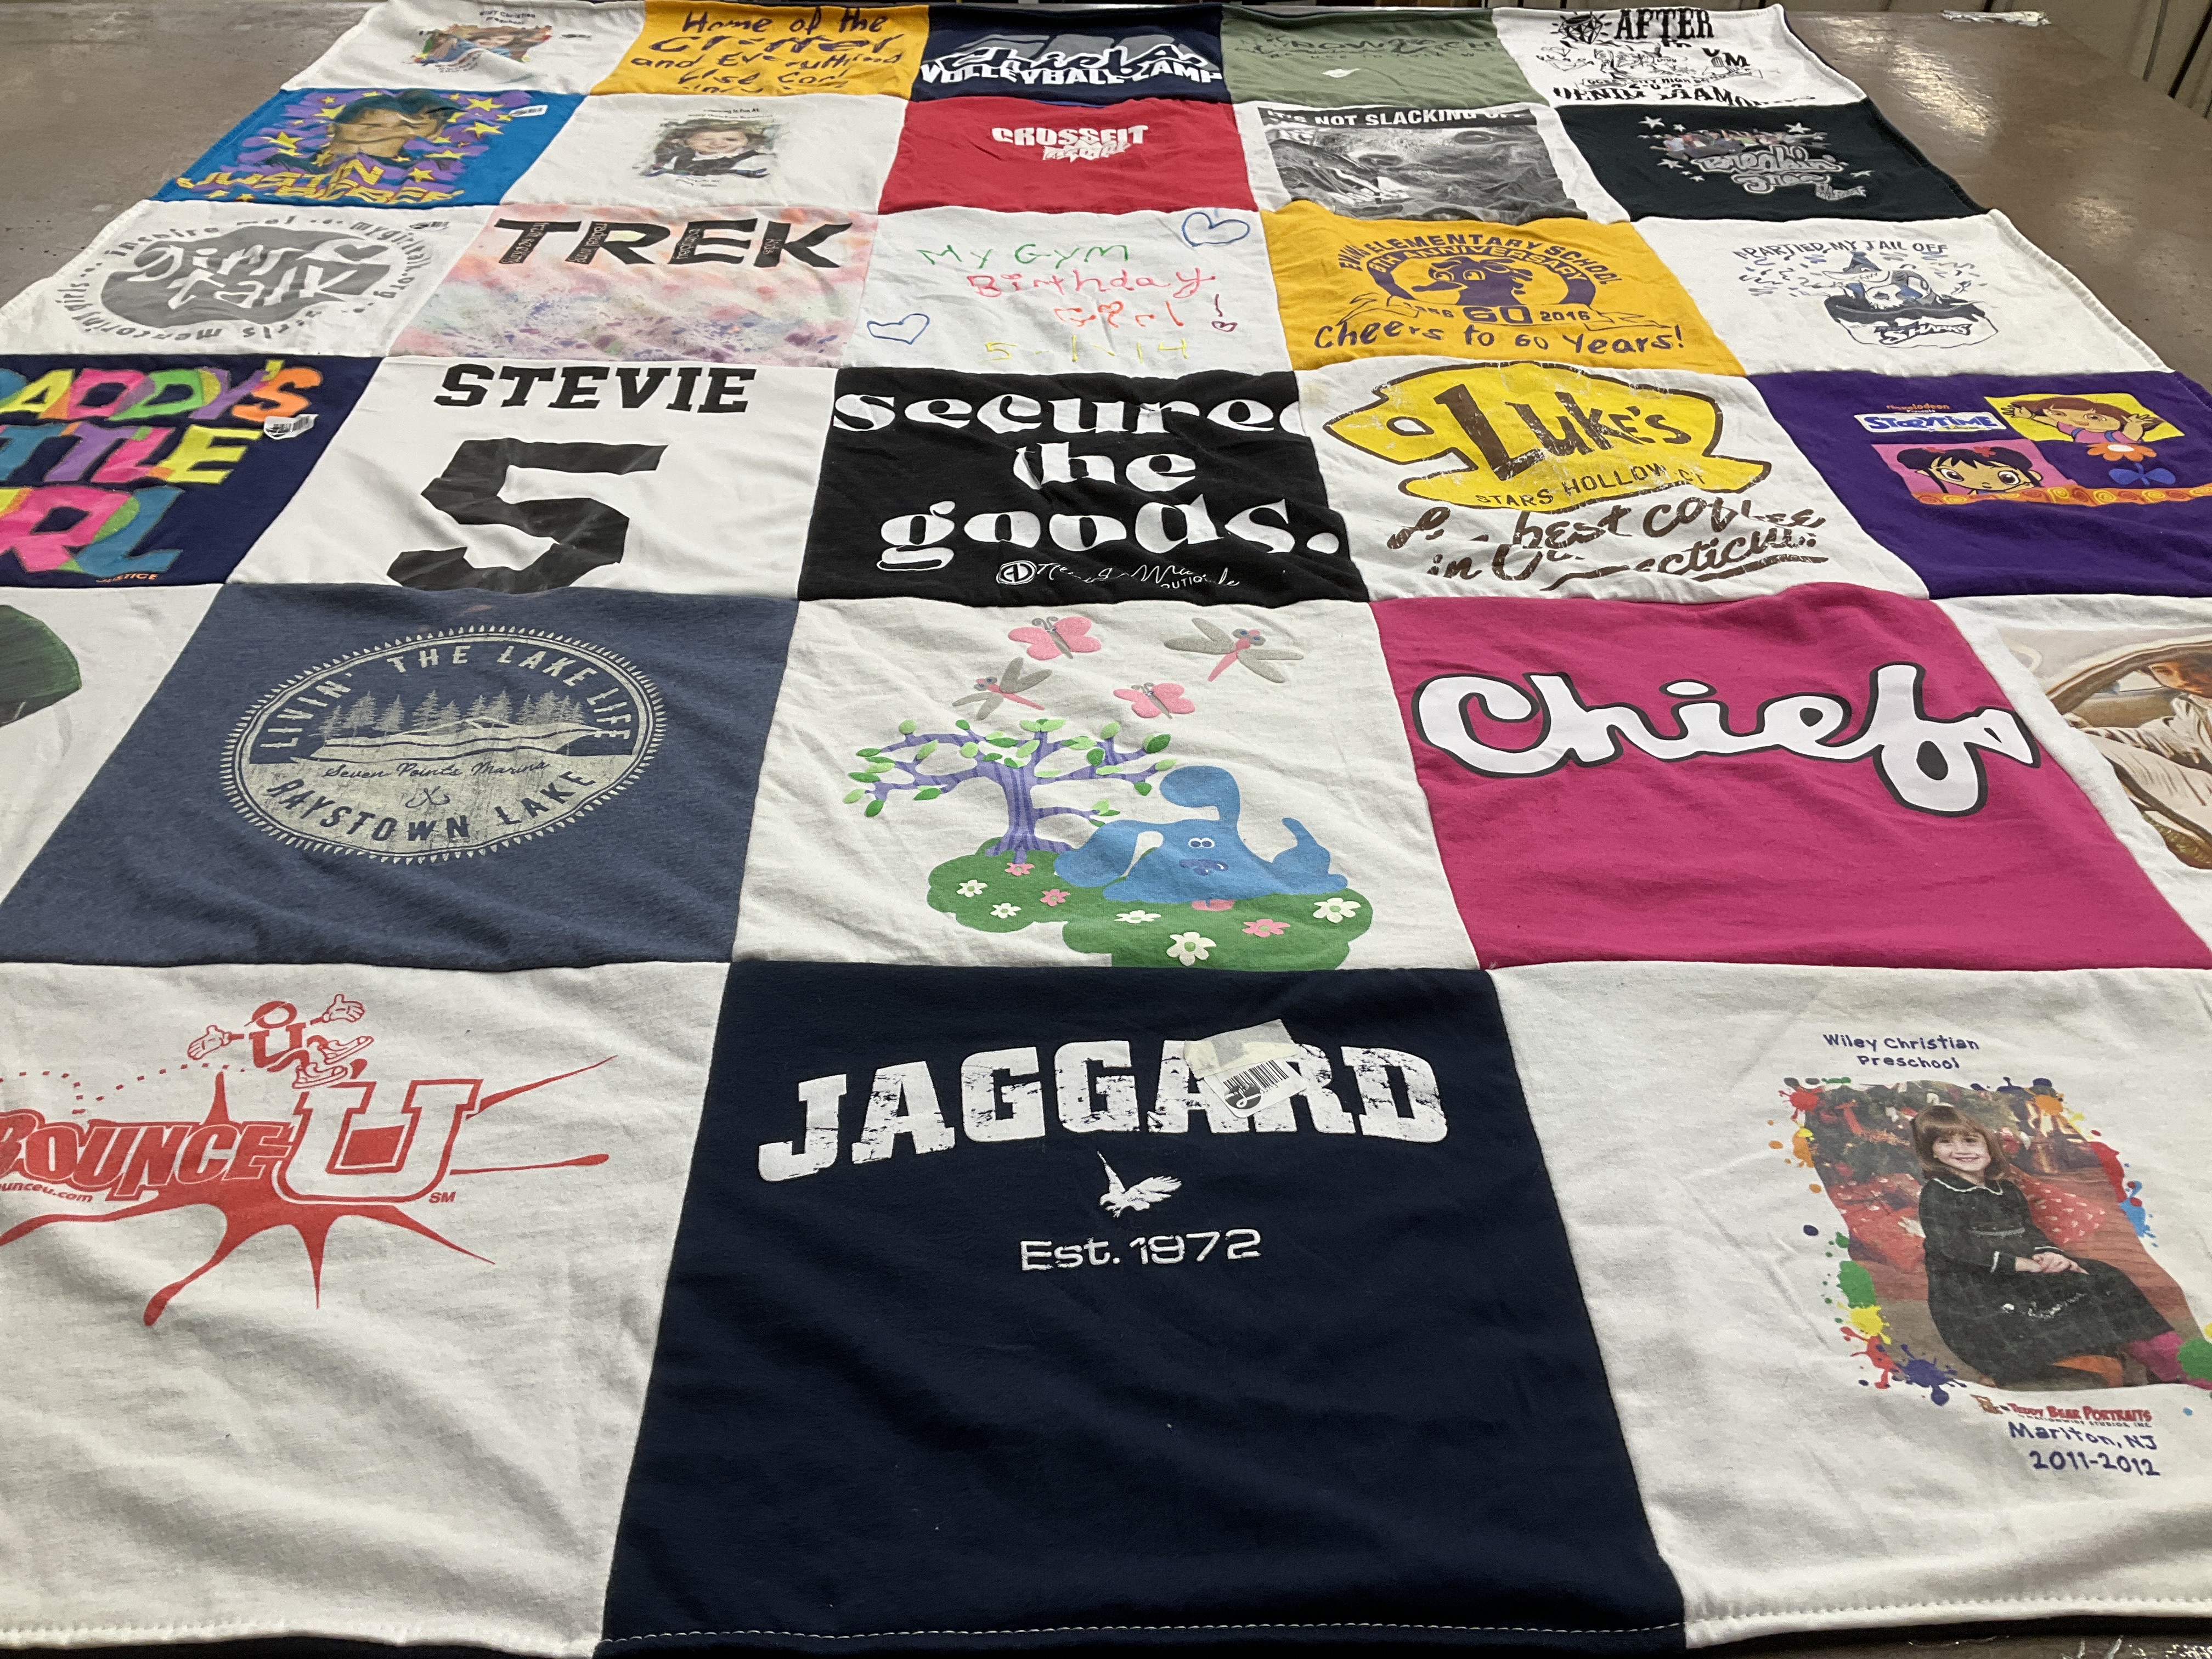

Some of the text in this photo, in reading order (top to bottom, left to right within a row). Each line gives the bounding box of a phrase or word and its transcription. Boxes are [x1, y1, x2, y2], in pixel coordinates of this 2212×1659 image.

[682, 5, 890, 35] Home of the
[1614, 8, 1714, 40] AFTER
[630, 53, 703, 69] and
[1314, 115, 1358, 126] NOT
[1364, 109, 1477, 126] SLACKING
[991, 125, 1149, 146] CROSSFIT
[494, 218, 853, 268] TREK
[762, 238, 782, 255] kids
[1829, 240, 1857, 251] MY
[1912, 242, 1949, 253] OFF
[1363, 234, 1543, 253] ELEMENTARY
[1544, 245, 1623, 285] SCHOOL
[1402, 245, 1589, 281] ANNIVERSARY
[967, 267, 1216, 298] Birthday
[1462, 305, 1534, 324] 60
[1539, 311, 1591, 322] 2016
[1313, 319, 1445, 349] Cheers
[1464, 324, 1496, 346] to
[1515, 333, 1550, 350] 60
[433, 364, 757, 414] STEVIE
[0, 421, 262, 484] TTLE
[1013, 441, 1196, 492] the
[1476, 486, 1554, 507] STARS
[386, 437, 669, 595] 5
[0, 486, 185, 577] RL
[876, 494, 1340, 572] goods.
[259, 644, 633, 750] LIVIN' THE LAKE LIFE
[322, 760, 551, 779] Seven Points Marina
[267, 770, 597, 842] RAYSTOWN LAKE
[1822, 1033, 1980, 1052] Wiley Christian
[1856, 1055, 1961, 1069] Preschool
[758, 1039, 1448, 1182] JAGGARD
[0, 1182, 93, 1203] unceu.com
[430, 1190, 456, 1205] SM
[1019, 1229, 1262, 1272] Est. 1972
[2083, 1405, 2153, 1422] PORTRAITS
[2007, 1421, 2158, 1451] Marlton, NJ
[2029, 1449, 2161, 1476] 2011-2012
